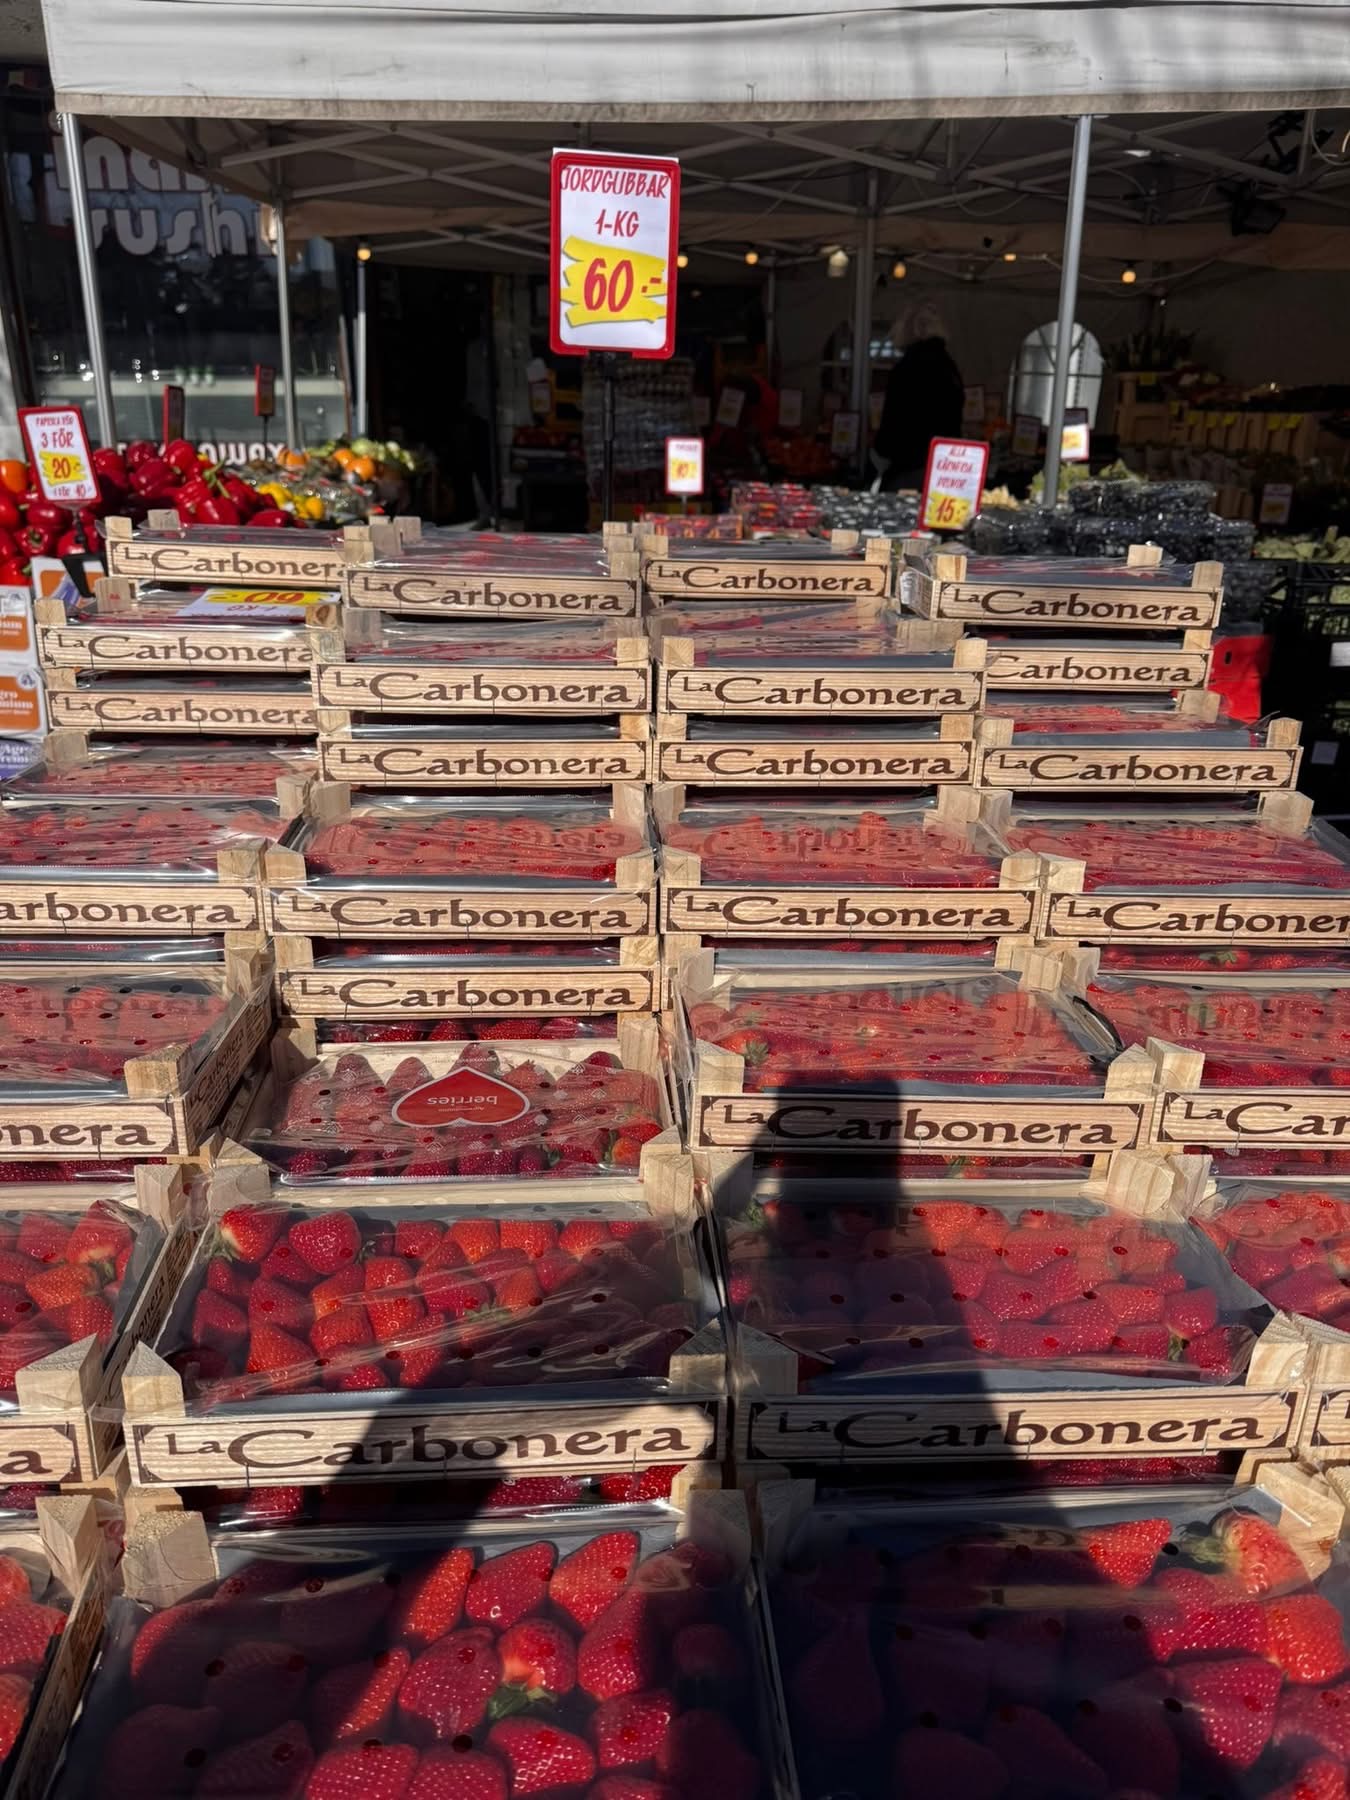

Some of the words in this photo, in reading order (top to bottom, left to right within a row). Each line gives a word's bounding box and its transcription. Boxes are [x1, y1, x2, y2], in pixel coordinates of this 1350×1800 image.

[561, 167, 669, 198] JORDGUBBAR
[596, 210, 639, 237] 1-KG
[41, 433, 48, 448] 3
[126, 547, 151, 560] La
[152, 549, 346, 578] Carboner
[658, 566, 682, 578] La
[683, 567, 873, 592] Carbonera
[364, 578, 393, 592] La
[394, 580, 622, 610] Carbonera
[954, 588, 980, 603] La
[981, 590, 1200, 622] Carbonera
[58, 633, 86, 648] La
[335, 672, 368, 688] La
[370, 673, 631, 703] Carbonera
[683, 677, 714, 693] La
[715, 678, 966, 706] Carbonera
[65, 697, 93, 711] La
[340, 748, 373, 764] La
[374, 748, 631, 776] Carbonera
[675, 750, 705, 765] La
[707, 749, 955, 776] Carbonera
[999, 756, 1029, 770] La
[1031, 754, 1277, 782] Carbonera
[291, 896, 330, 913] La
[329, 897, 631, 928] Carbonera
[687, 895, 722, 913] La
[723, 897, 1013, 927] Carbonera
[1068, 901, 1102, 917] La
[299, 979, 340, 996] La
[340, 980, 634, 1007] Carbonera
[426, 1095, 498, 1105] berries
[1185, 1102, 1226, 1120] La
[724, 1105, 767, 1125] La
[769, 1106, 1116, 1144] Carbonera
[779, 1412, 830, 1433] La
[835, 1410, 1263, 1448] Carbonera
[168, 1434, 225, 1455] La
[227, 1424, 691, 1469] Carbonera
